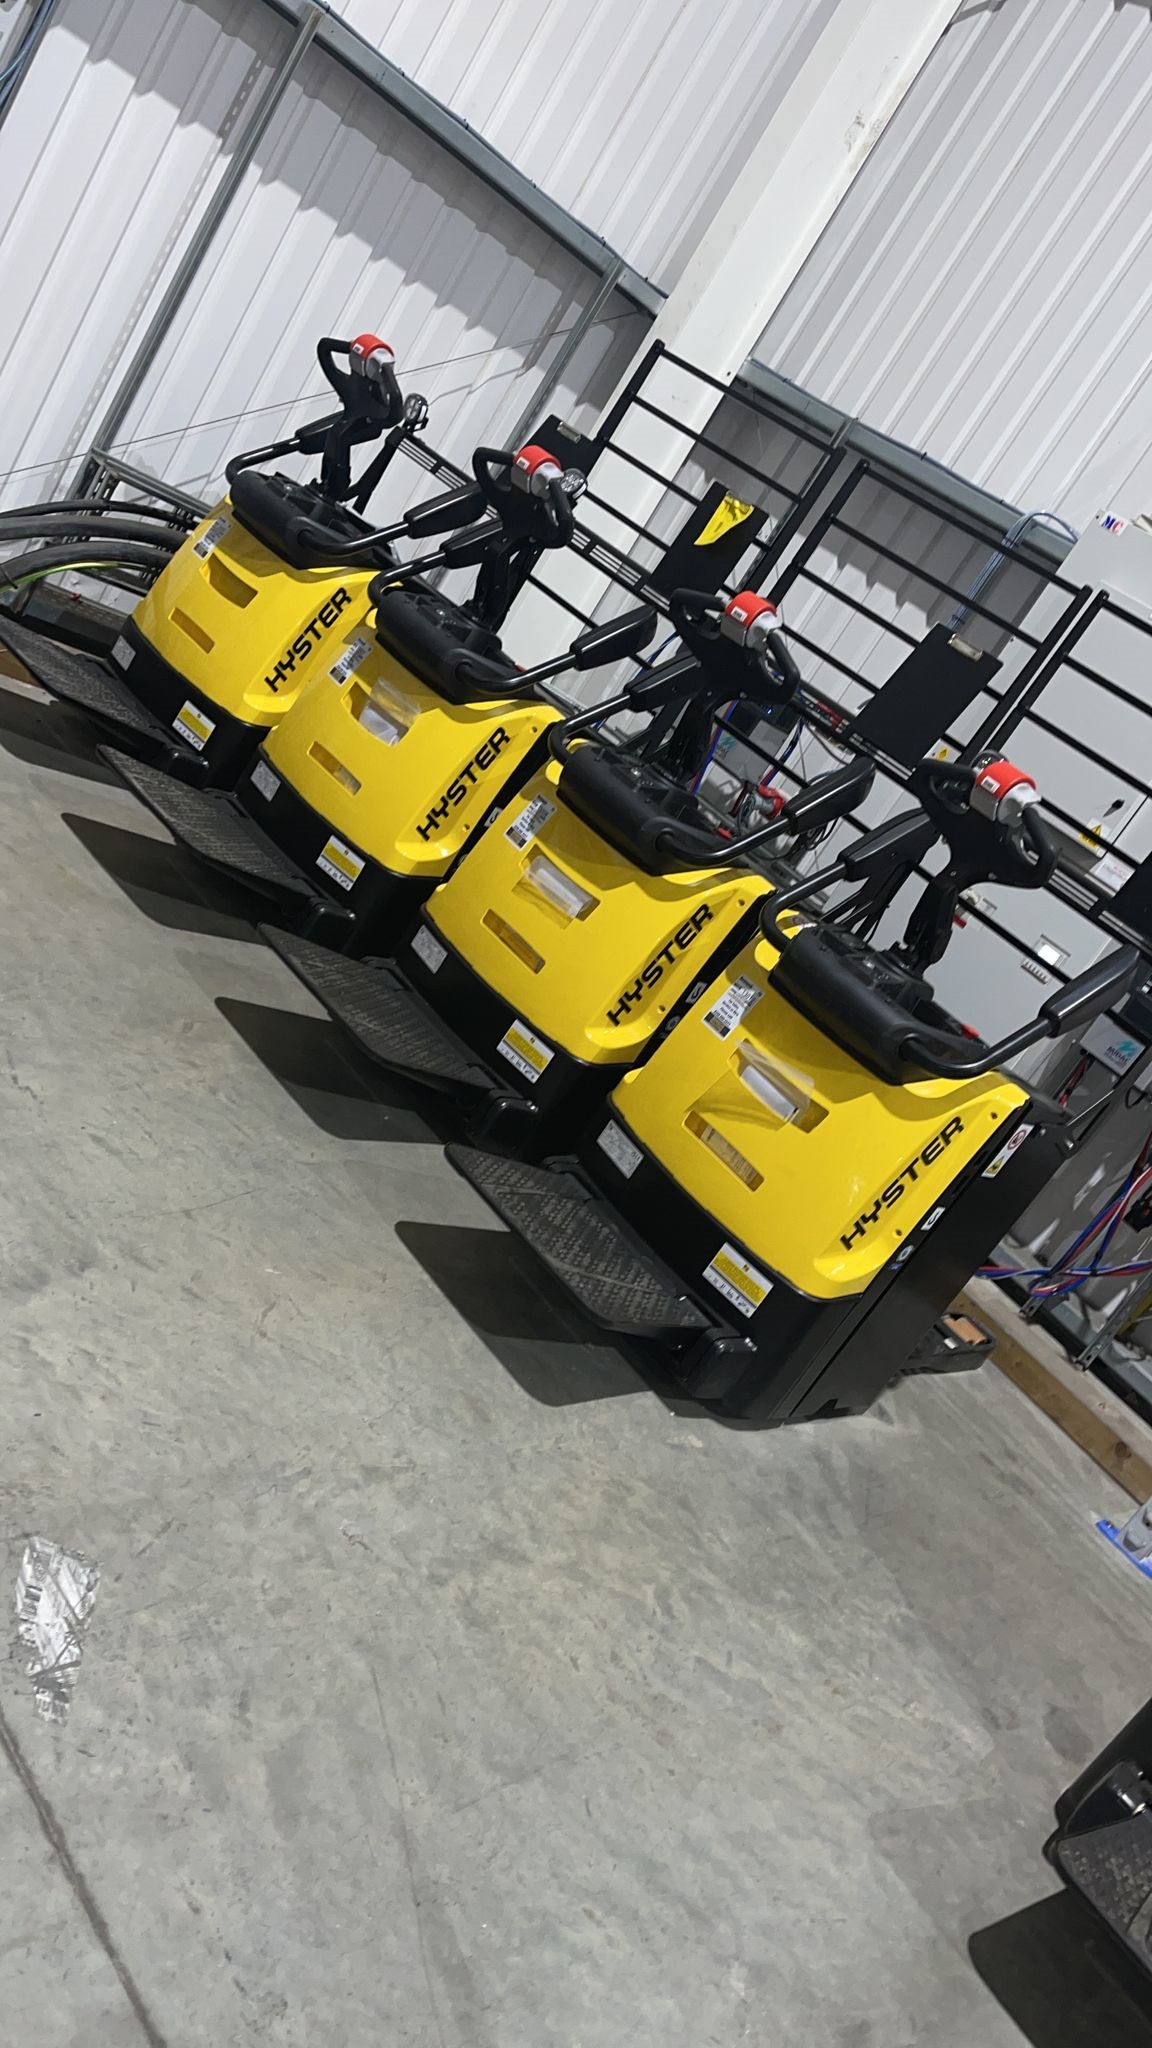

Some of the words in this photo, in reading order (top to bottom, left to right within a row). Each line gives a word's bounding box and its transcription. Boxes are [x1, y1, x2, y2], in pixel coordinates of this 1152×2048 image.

[264, 587, 352, 693] HYSTER
[416, 726, 511, 842] HYSTER
[606, 903, 714, 1027] HYSTER
[840, 1116, 965, 1251] HYSTER
